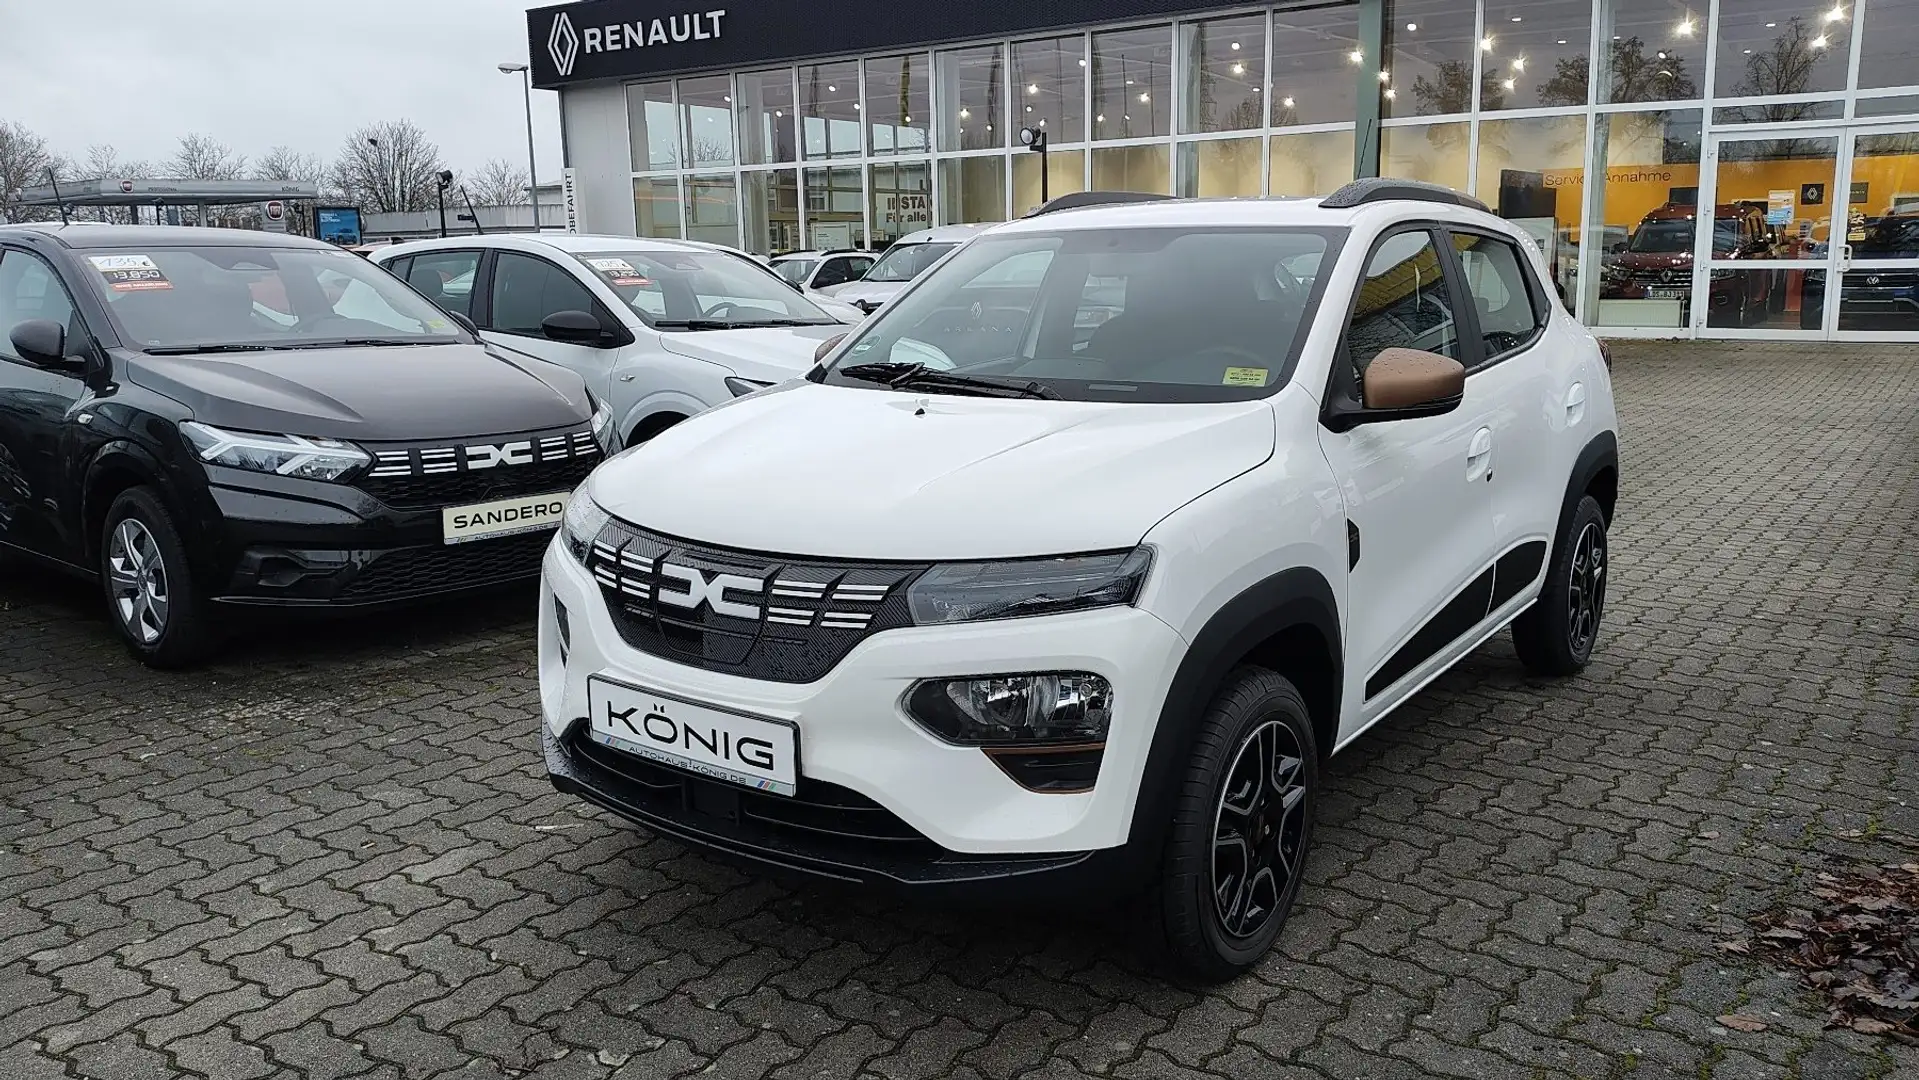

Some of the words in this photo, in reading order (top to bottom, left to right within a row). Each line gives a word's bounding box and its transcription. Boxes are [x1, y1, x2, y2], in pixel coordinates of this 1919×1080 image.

[584, 10, 726, 54] RENAULT
[1545, 174, 1584, 186] Servic
[907, 211, 926, 222] alle
[453, 502, 563, 529] SANDERO
[607, 701, 774, 771] KÖNIG
